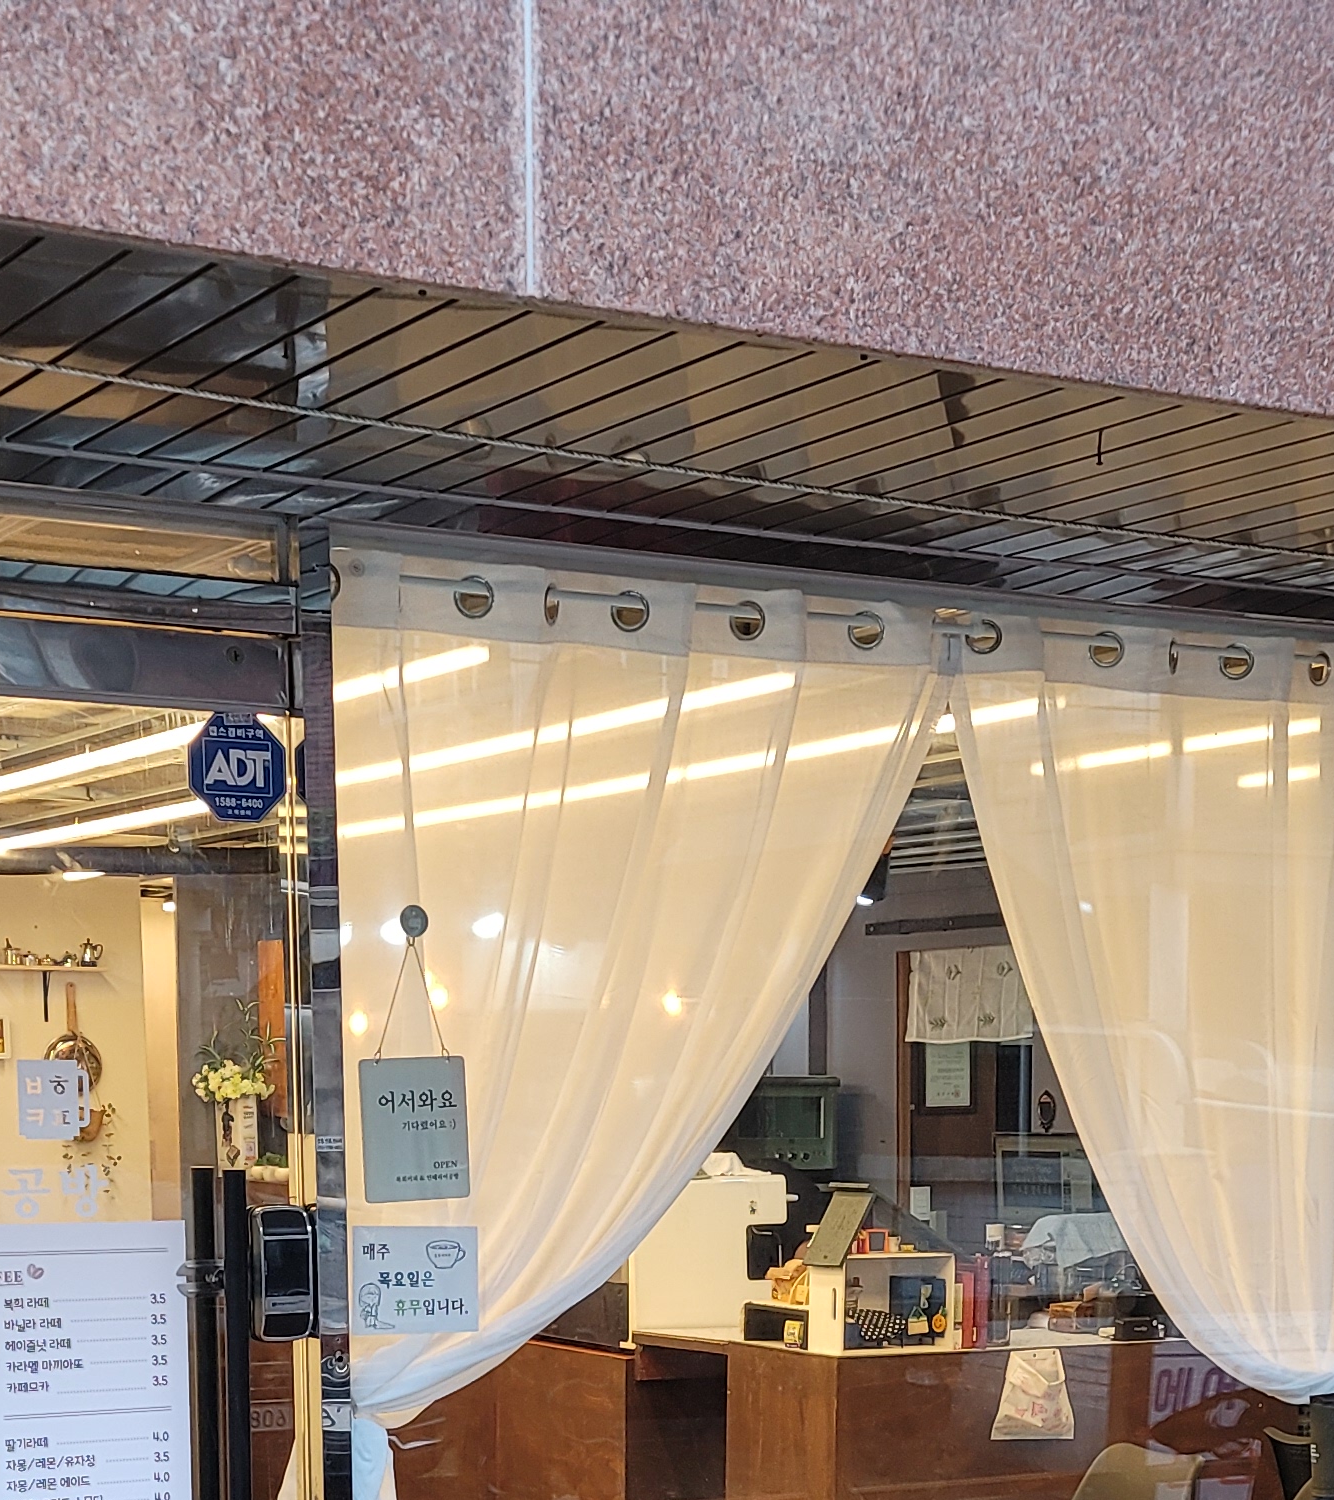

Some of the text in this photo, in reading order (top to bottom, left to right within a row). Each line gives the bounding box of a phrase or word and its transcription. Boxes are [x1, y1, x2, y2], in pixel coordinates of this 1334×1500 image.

[205, 749, 270, 787] ADT
[215, 797, 263, 808] 1588-6400
[378, 1089, 458, 1113] 어서와요
[402, 1119, 447, 1131] 기다렸어요
[433, 1160, 458, 1169] OPEN
[363, 1243, 391, 1261] 매주
[378, 1271, 435, 1288] 목요일은
[4, 1293, 167, 1311] 복희 라떼 3.5
[394, 1298, 469, 1317] 휴무입니다.
[4, 1313, 167, 1333] 바닐라 라떼 3.5
[5, 1334, 167, 1353] 헤이즐넛 라떼 3.5
[6, 1355, 168, 1374] 카라멜 마끼아또 3.5
[6, 1375, 169, 1394] 카페모카 3.5
[4, 1431, 169, 1452] 딸기라떼 4.0
[153, 1451, 170, 1462] 3.5
[6, 1471, 170, 1493] 자몽/레몬 에이드 4.0
